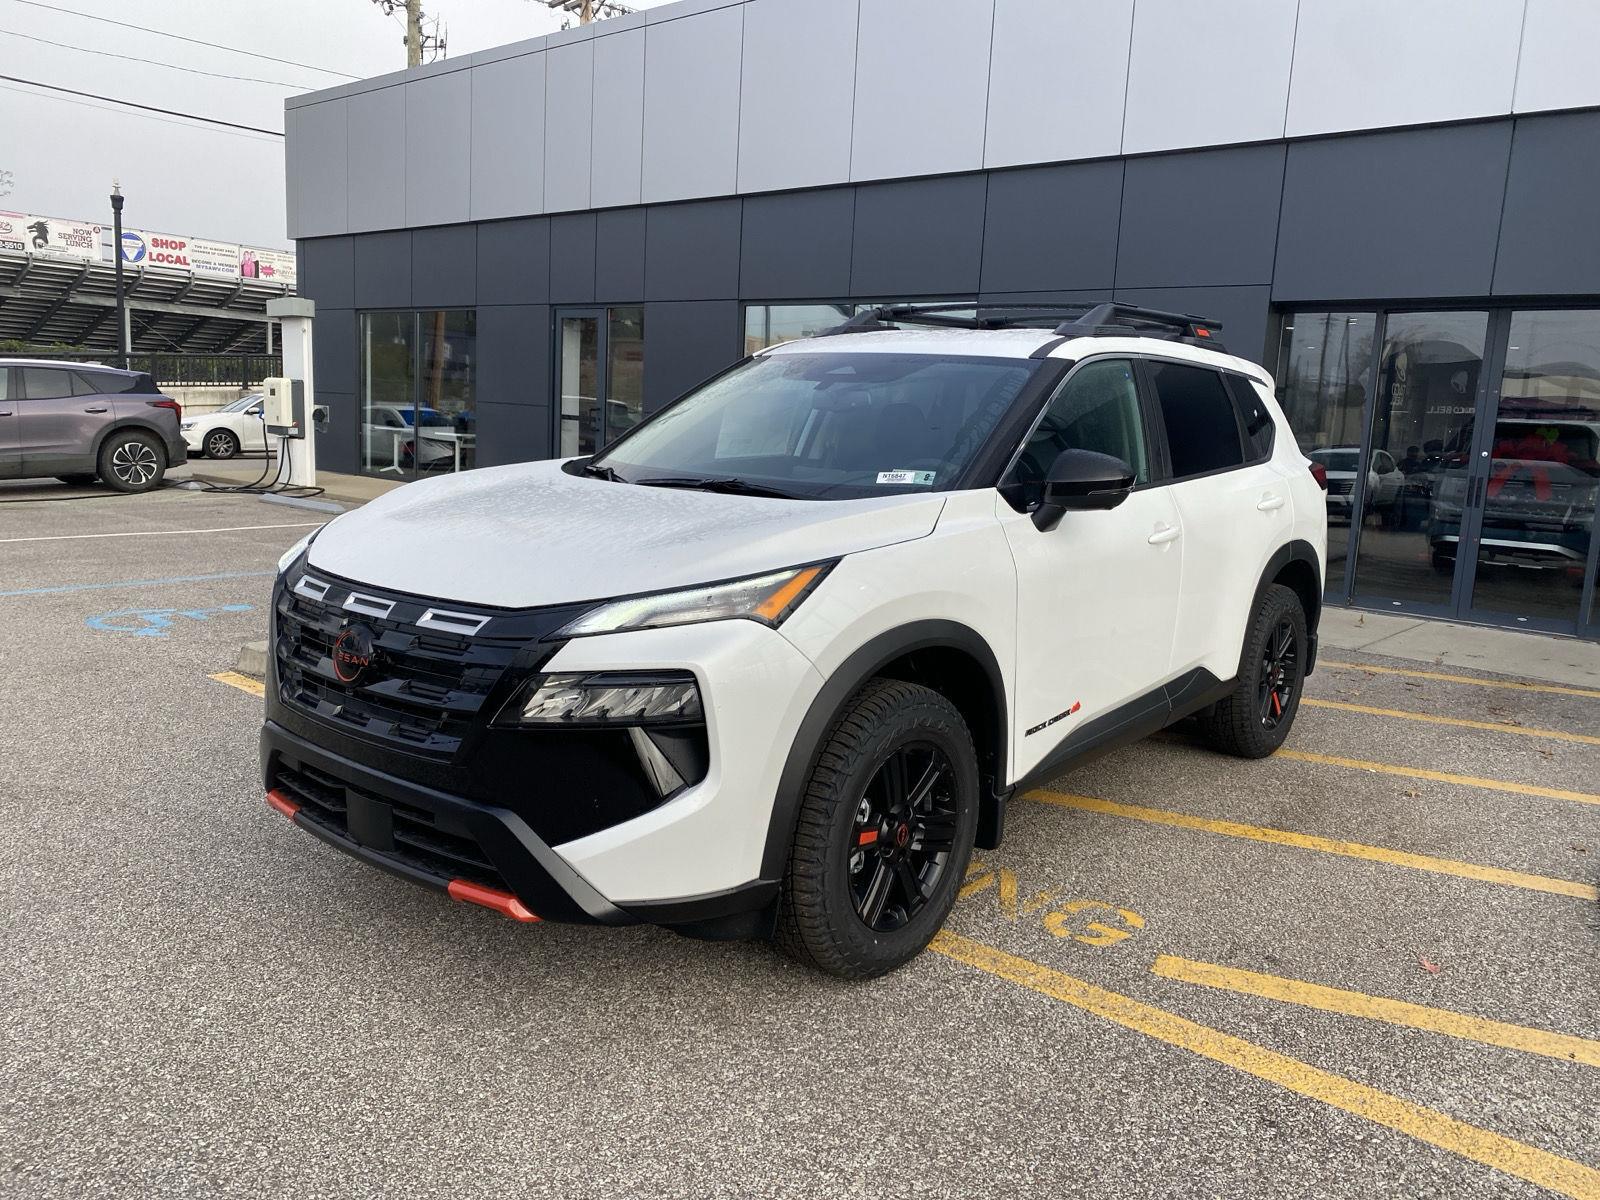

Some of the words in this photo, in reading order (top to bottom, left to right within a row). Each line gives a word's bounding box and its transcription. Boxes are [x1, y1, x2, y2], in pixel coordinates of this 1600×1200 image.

[58, 232, 93, 242] SERVING
[73, 228, 93, 236] NOW
[65, 239, 93, 249] LUNCH
[151, 237, 187, 251] SHOP
[148, 251, 190, 266] LOCAL
[1025, 720, 1048, 738] ROCK
[1048, 708, 1071, 726] CREEK
